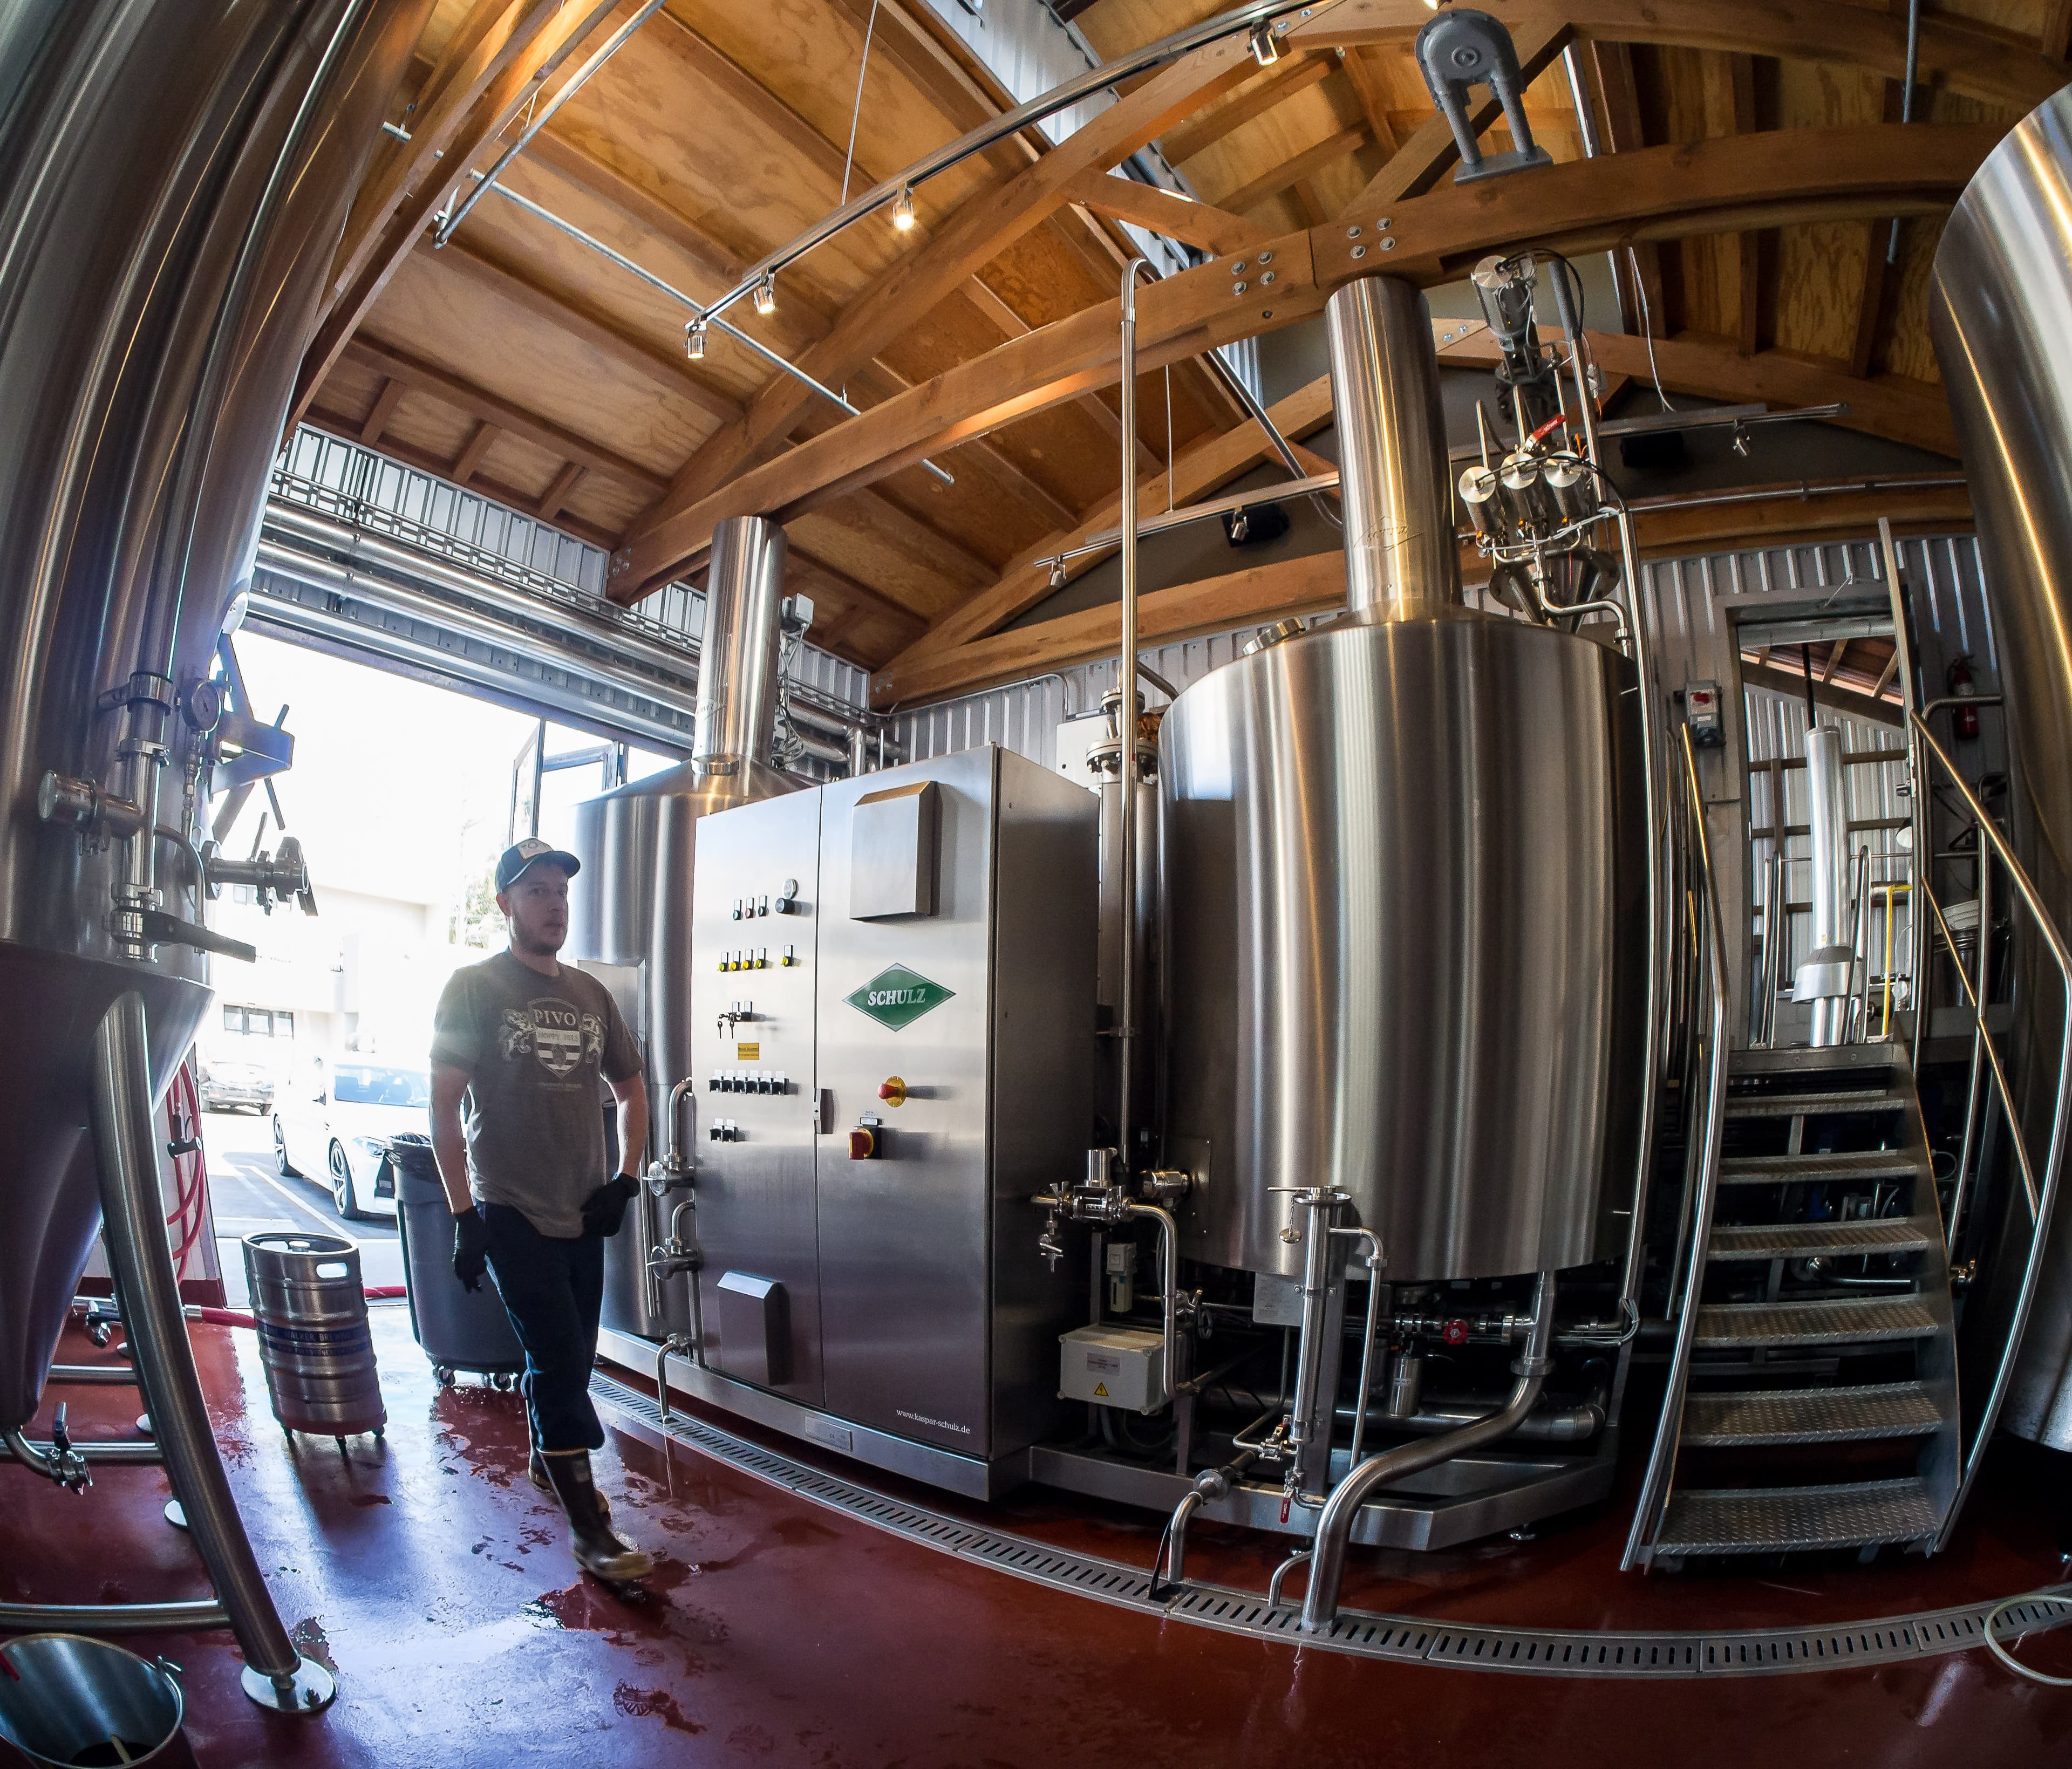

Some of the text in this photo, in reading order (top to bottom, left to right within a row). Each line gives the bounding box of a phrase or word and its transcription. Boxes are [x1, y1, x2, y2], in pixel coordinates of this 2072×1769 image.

[868, 988, 926, 1006] SCHULZ
[533, 1009, 576, 1026] PIVO
[896, 1410, 971, 1435] www.kaspar-schulz.de
